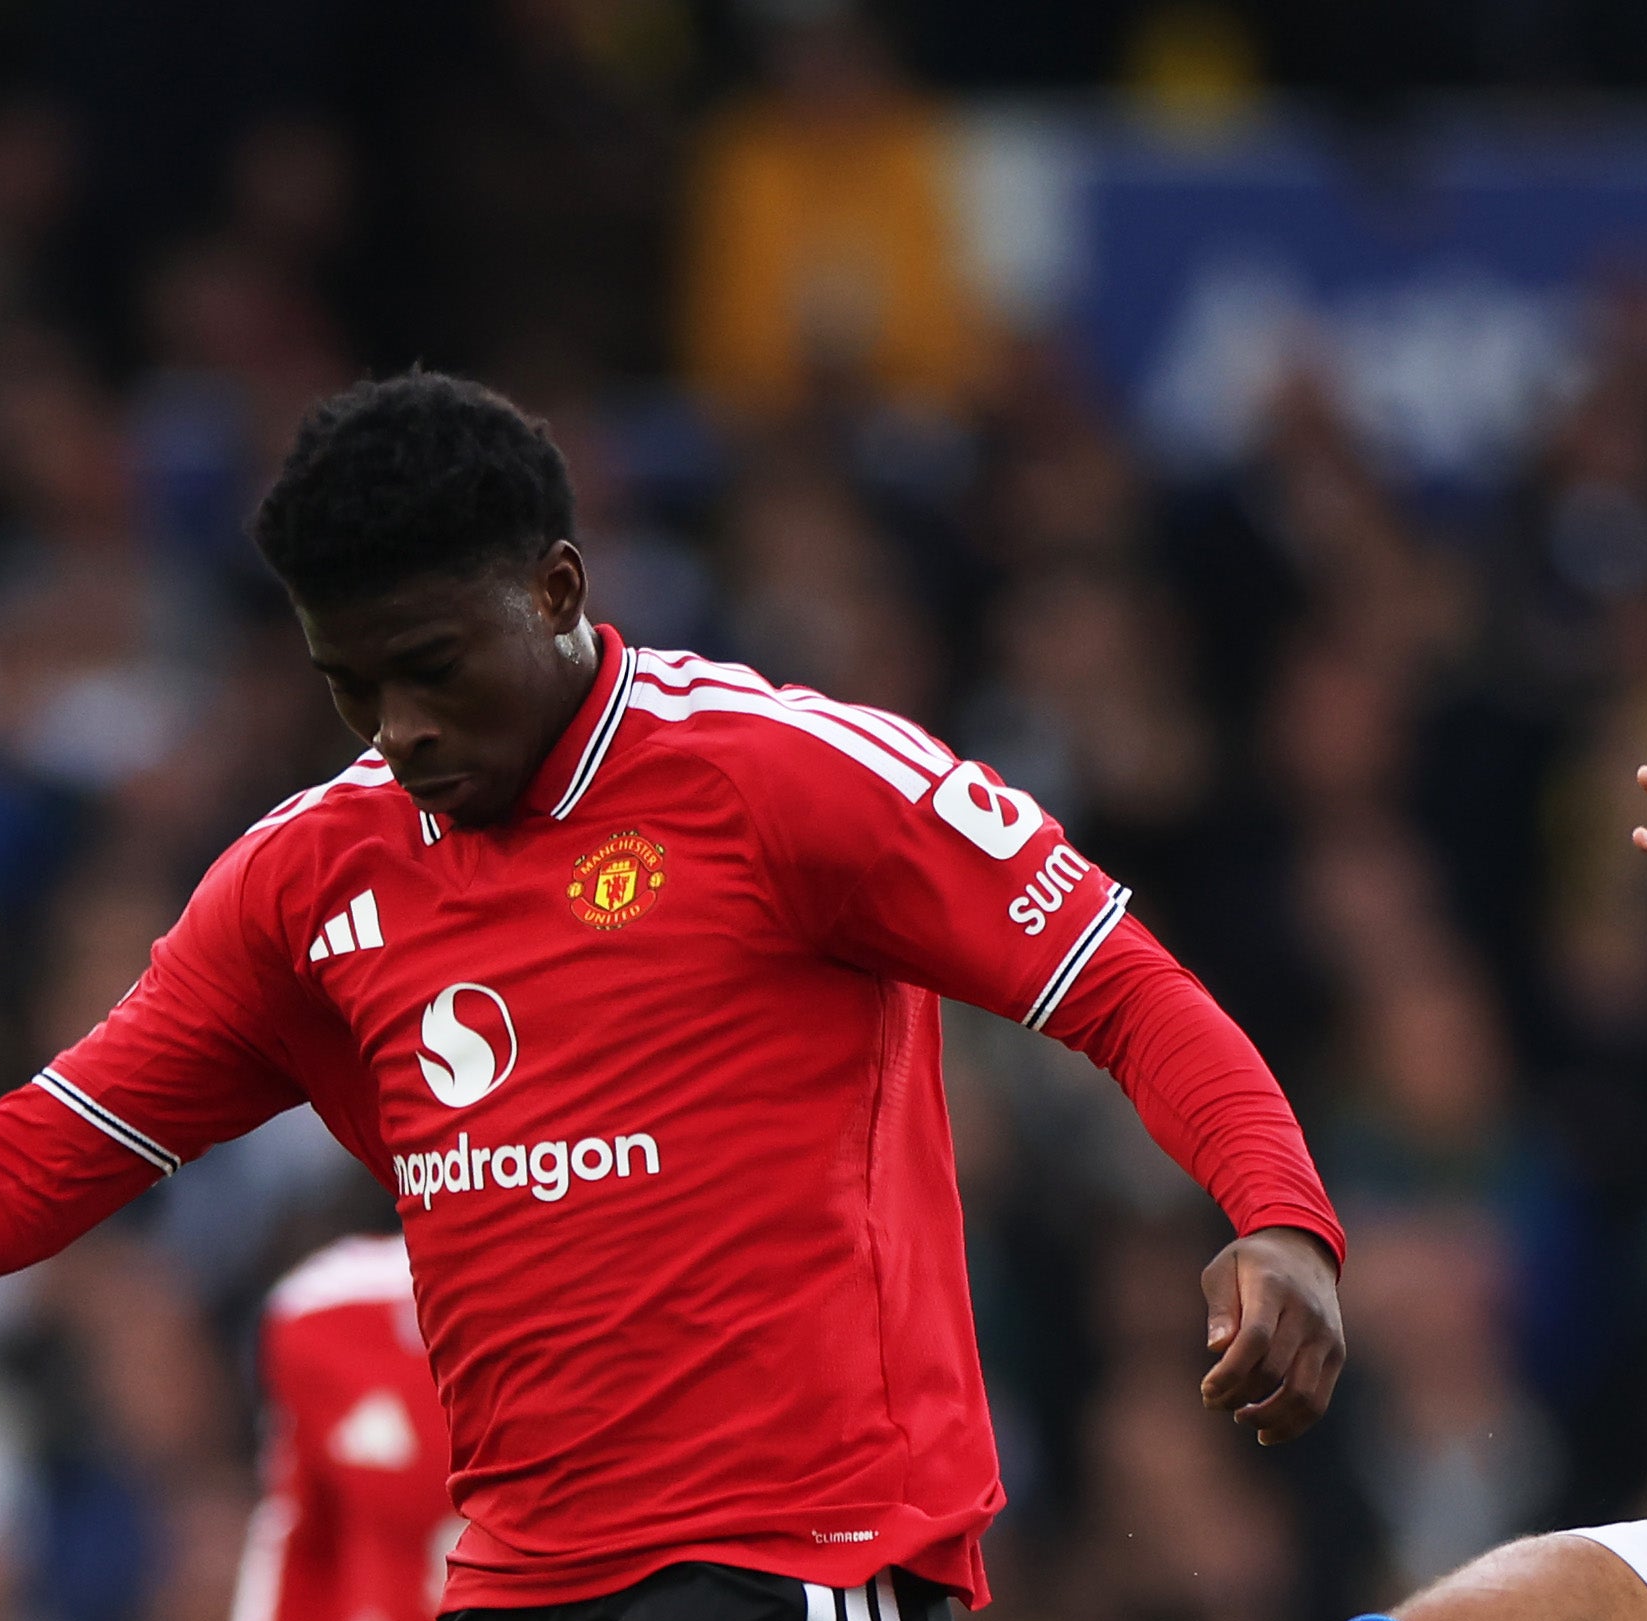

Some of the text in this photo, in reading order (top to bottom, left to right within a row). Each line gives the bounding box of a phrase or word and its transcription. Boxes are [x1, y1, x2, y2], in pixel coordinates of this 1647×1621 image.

[580, 838, 658, 875] MANCHESTER
[584, 904, 641, 924] UNITED
[1008, 843, 1091, 936] sum
[393, 1131, 661, 1211] napdragon
